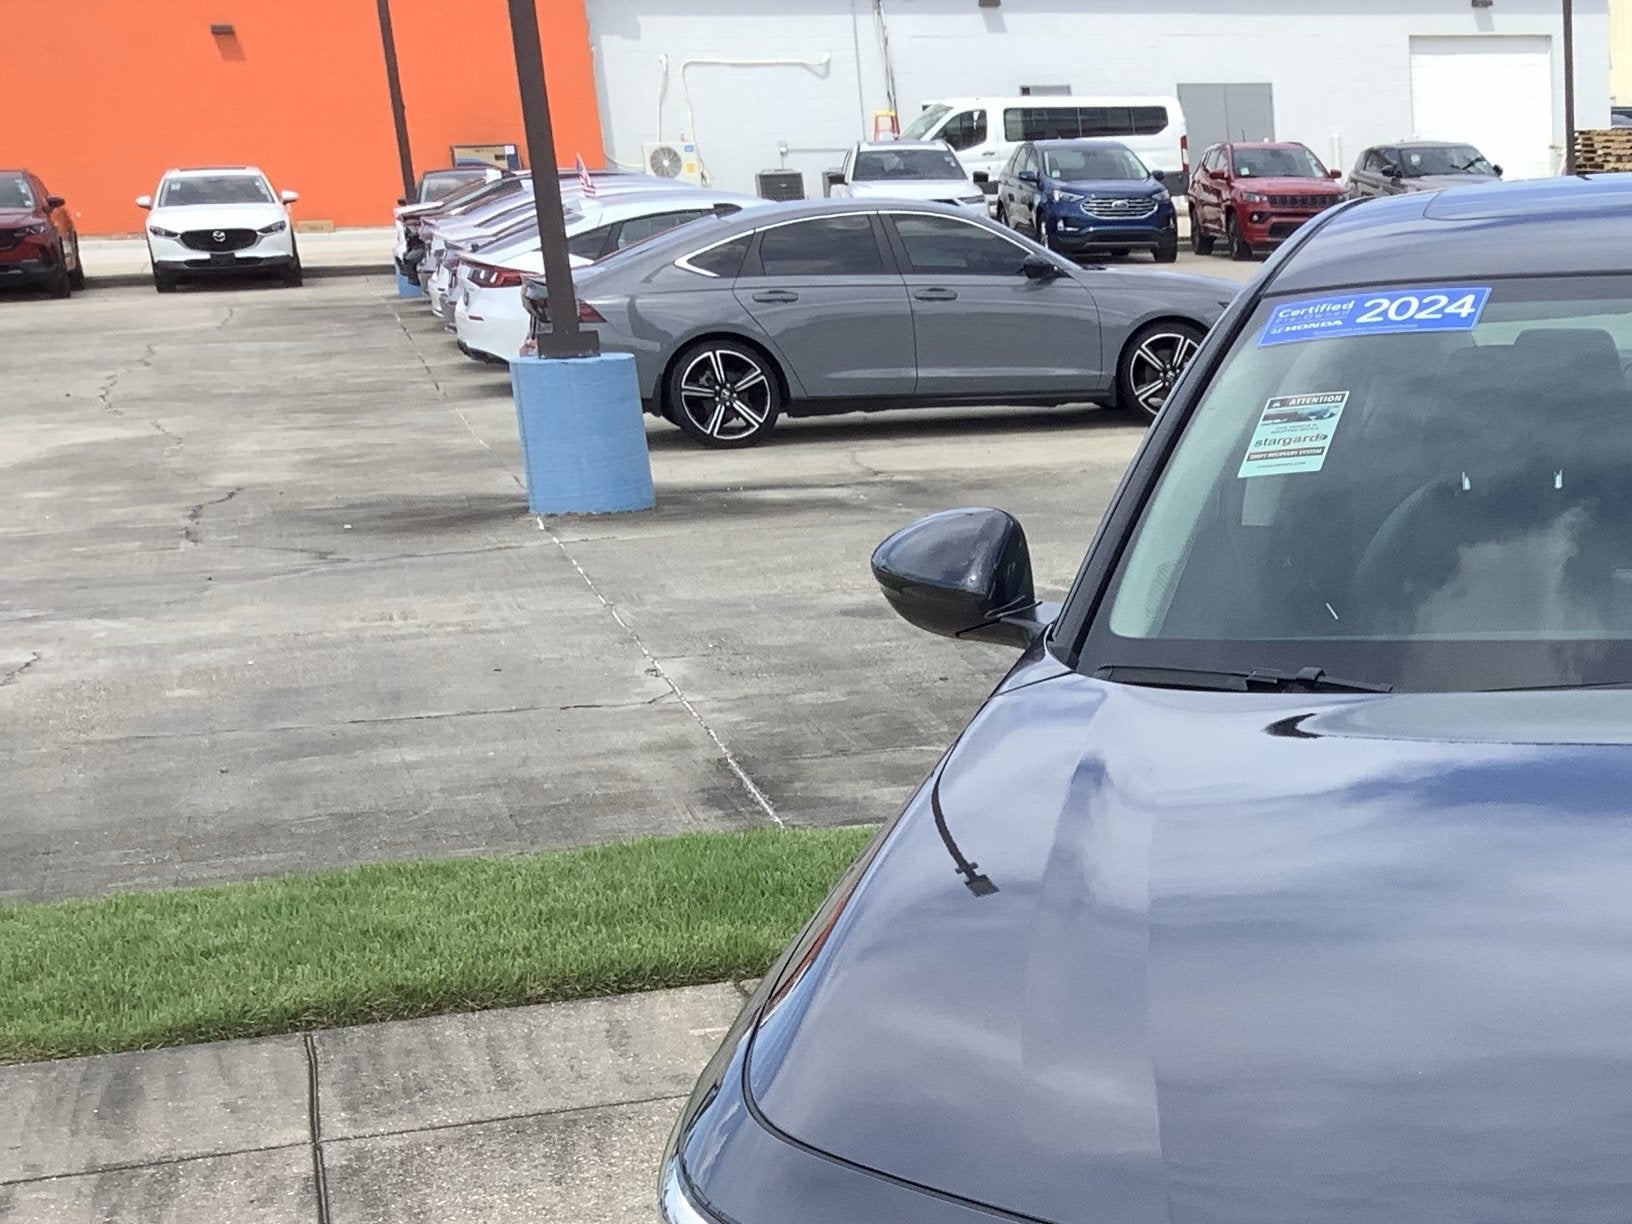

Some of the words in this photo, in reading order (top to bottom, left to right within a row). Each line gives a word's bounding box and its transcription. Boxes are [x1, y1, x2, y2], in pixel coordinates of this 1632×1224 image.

[1278, 300, 1354, 319] Certified
[1355, 294, 1476, 324] 2024
[1284, 319, 1344, 333] HONDA
[1289, 395, 1343, 406] ATTENTION
